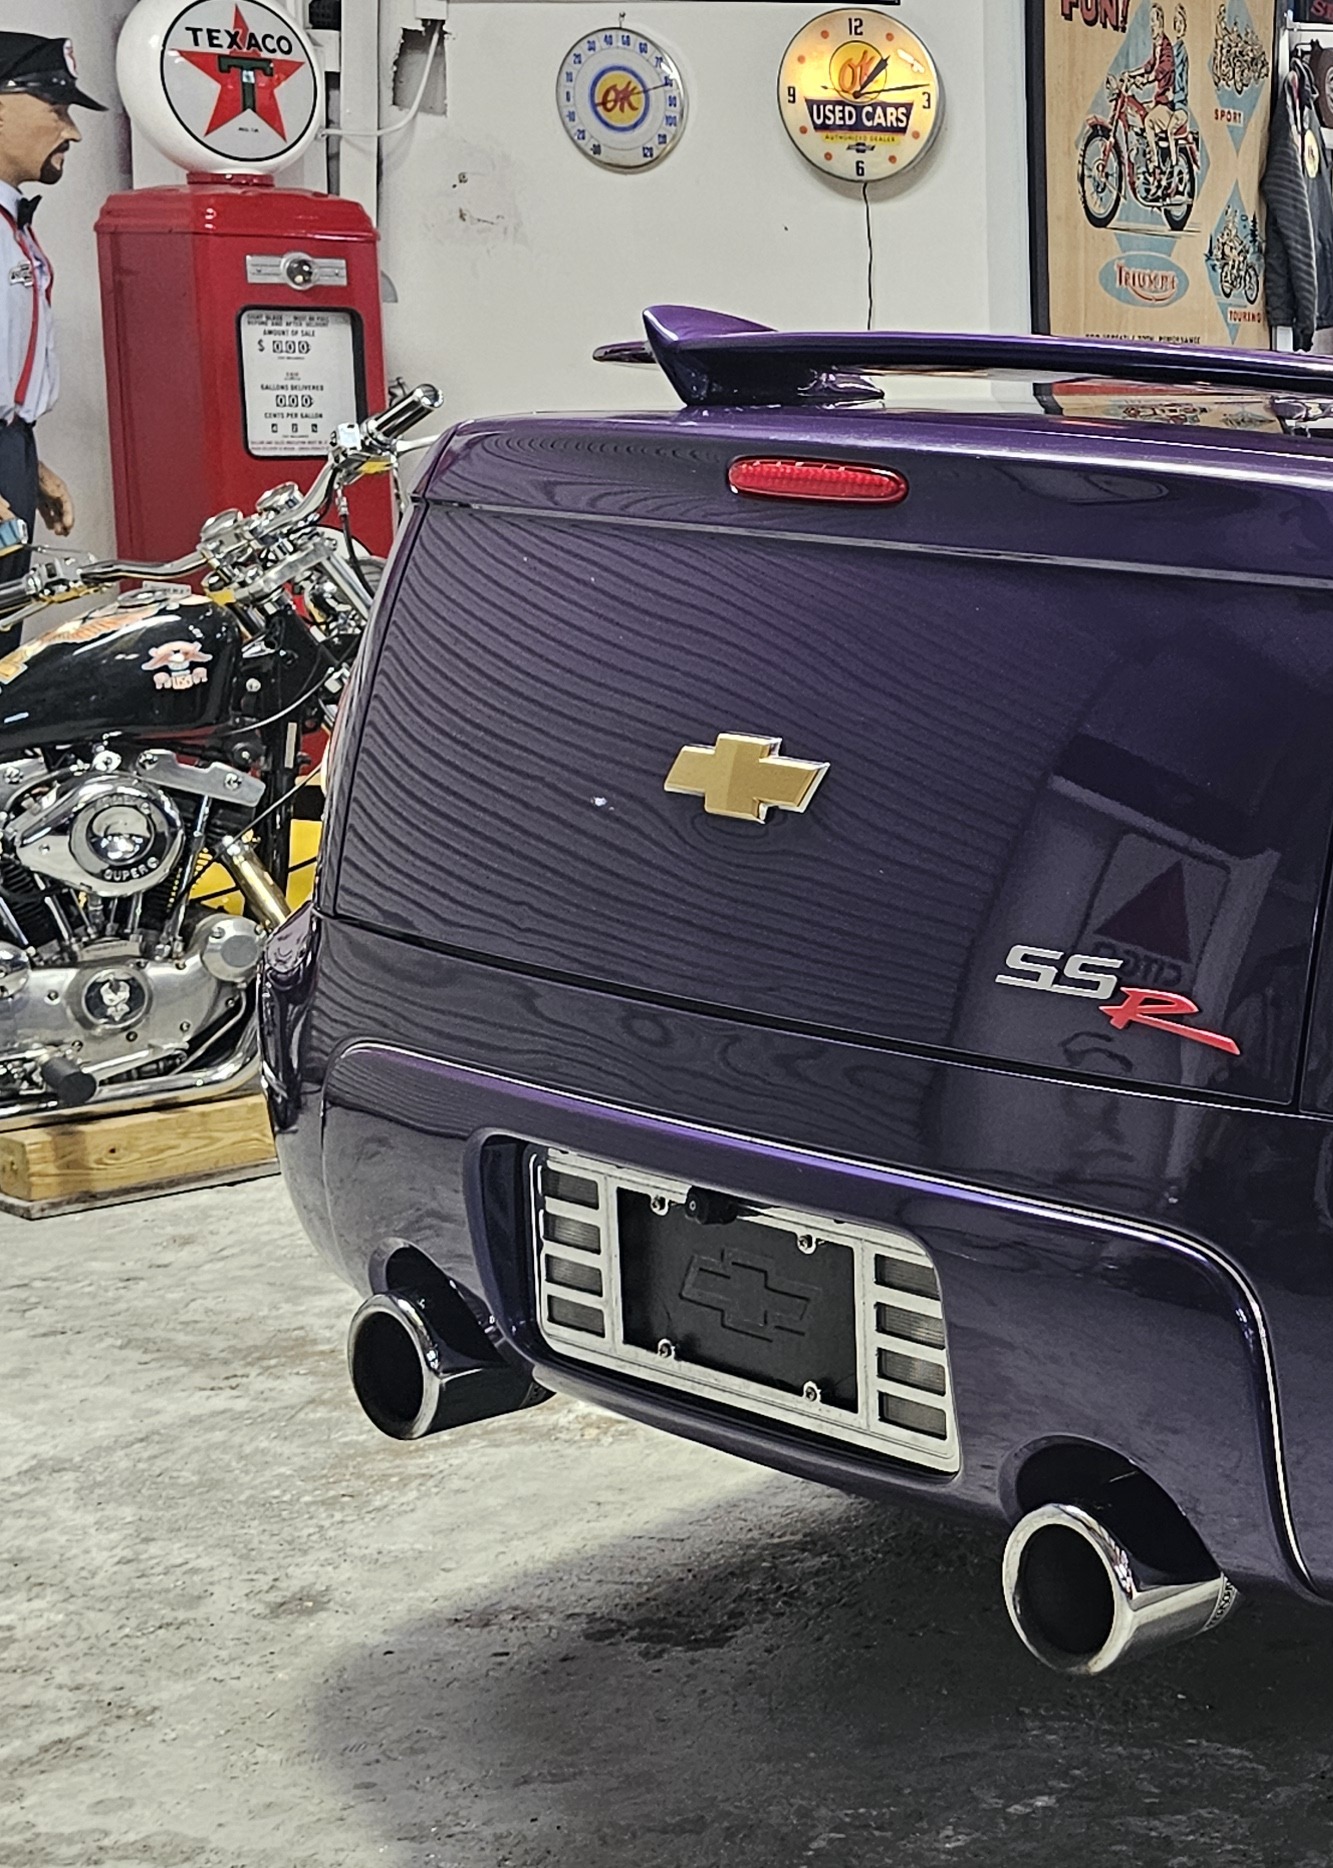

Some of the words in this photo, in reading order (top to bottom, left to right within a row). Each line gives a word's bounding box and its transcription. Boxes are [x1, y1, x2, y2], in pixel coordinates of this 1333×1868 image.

[848, 18, 864, 36] 12
[185, 26, 293, 55] TEXACO
[601, 81, 639, 113] OK
[787, 86, 796, 104] 9
[922, 92, 931, 109] 3
[813, 104, 856, 126] USED
[861, 106, 907, 128] CARS
[1214, 108, 1242, 124] SPORT
[855, 160, 865, 177] 6
[1115, 260, 1178, 299] TRIUMPH
[1228, 310, 1262, 323] TOURING
